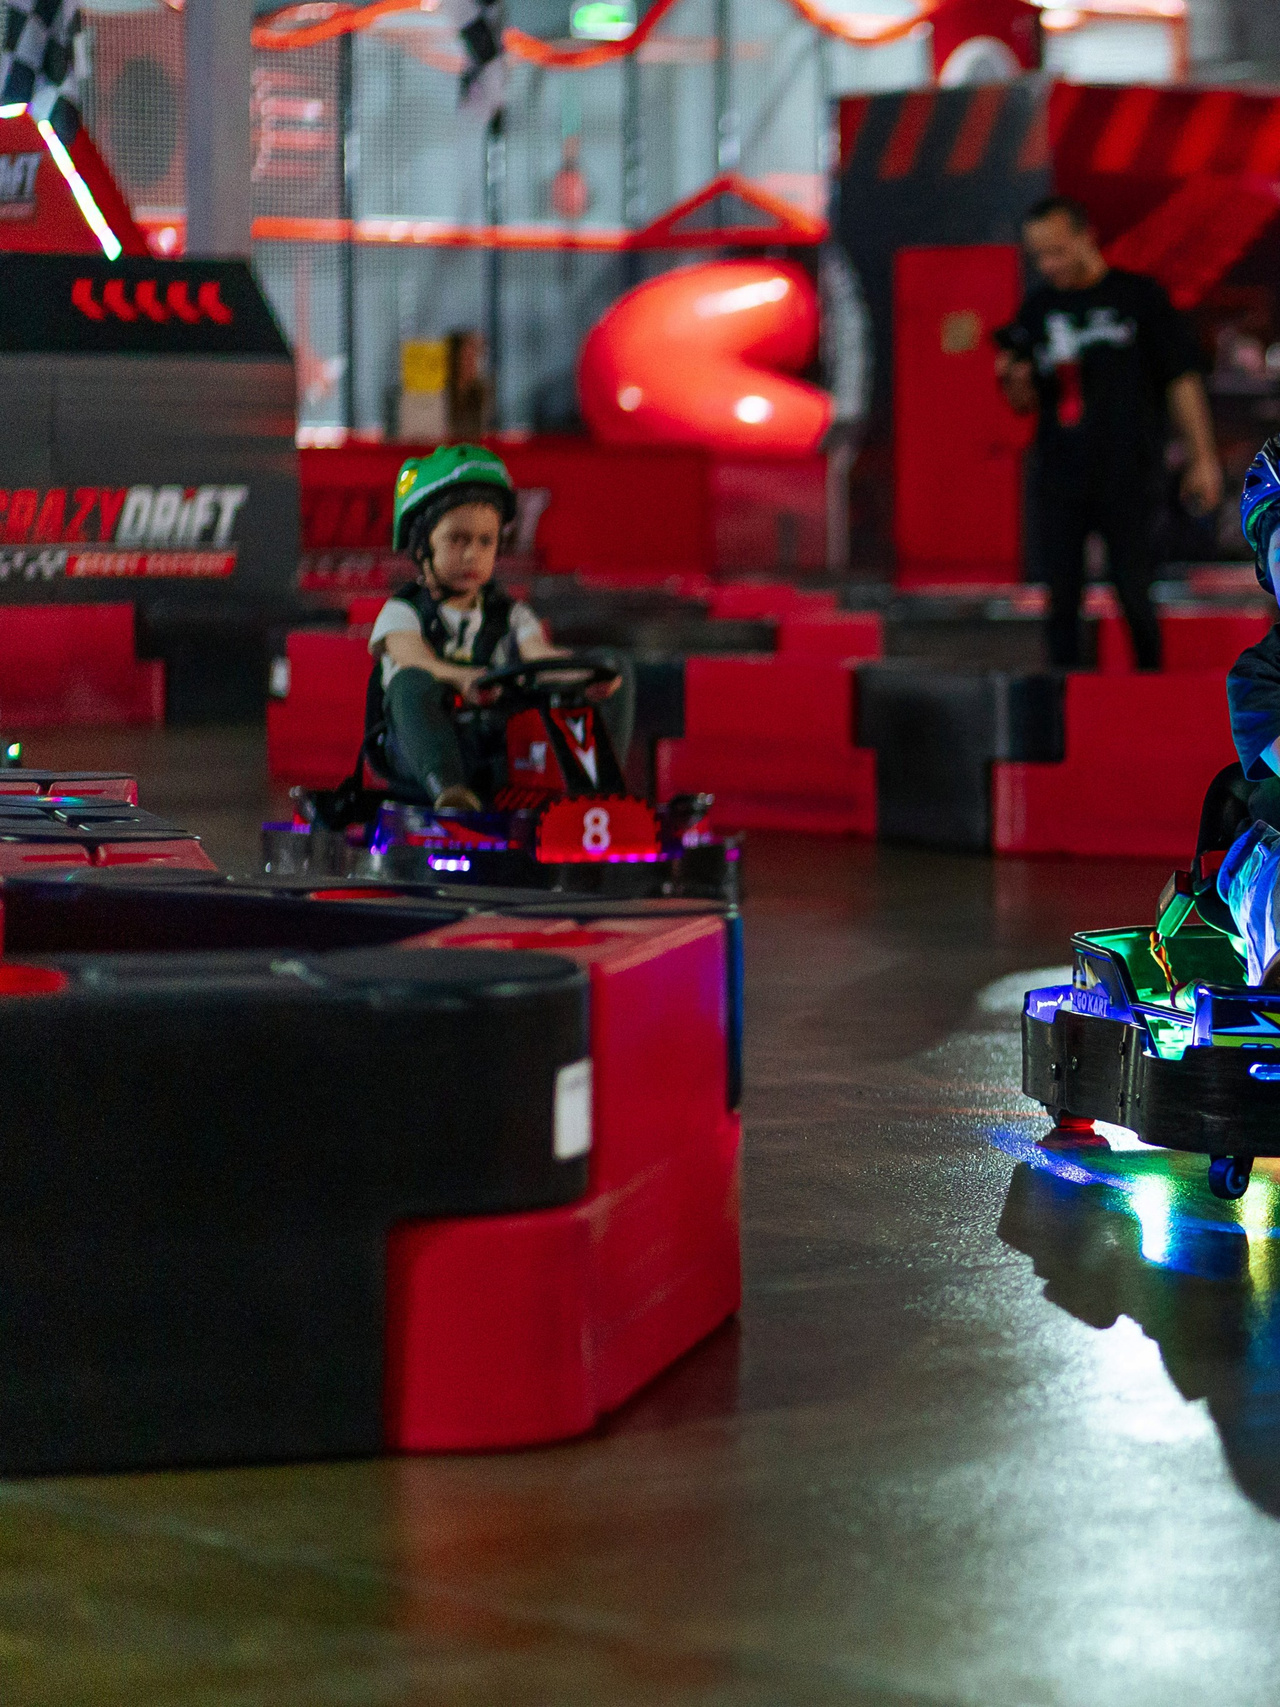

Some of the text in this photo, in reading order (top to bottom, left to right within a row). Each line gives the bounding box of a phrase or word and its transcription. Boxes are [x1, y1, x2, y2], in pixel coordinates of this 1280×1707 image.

[582, 807, 611, 852] 8
[1077, 992, 1108, 1017] GO KART
